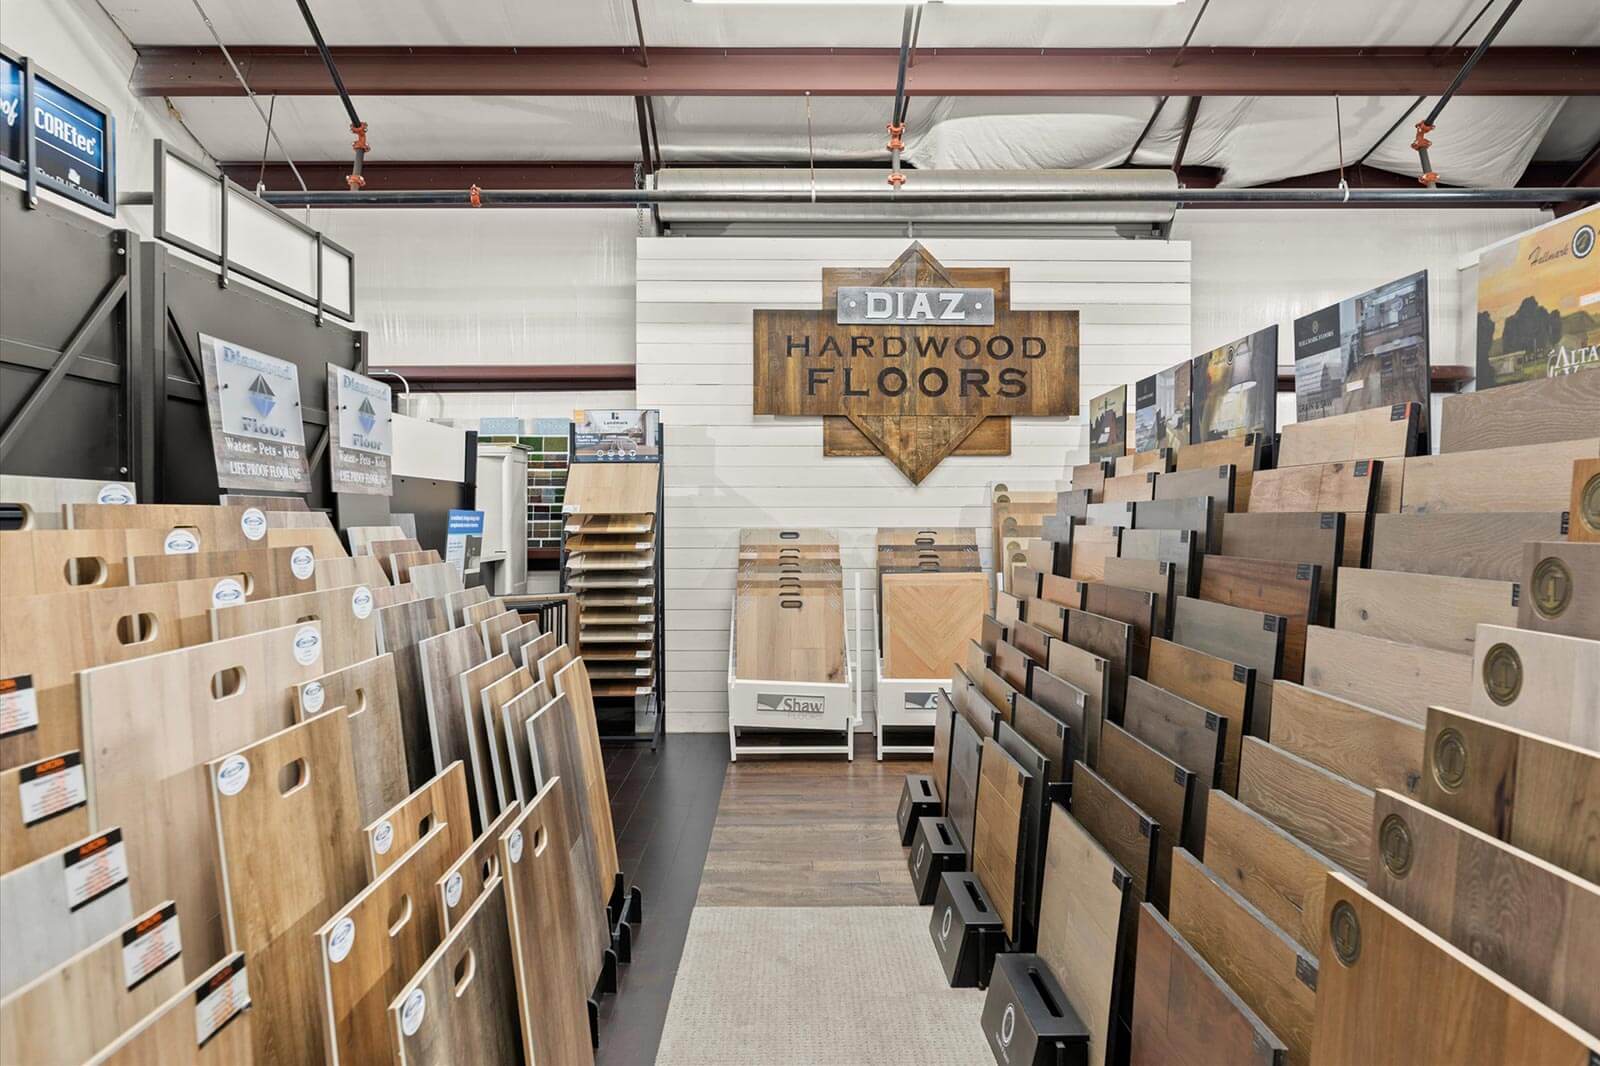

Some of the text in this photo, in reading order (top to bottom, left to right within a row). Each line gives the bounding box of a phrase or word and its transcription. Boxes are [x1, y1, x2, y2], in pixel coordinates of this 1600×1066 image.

[1528, 244, 1569, 266] Hallmark
[865, 291, 966, 320] DIAZ
[786, 335, 1046, 360] HARDWOOD
[1555, 345, 1599, 369] ALTA
[807, 366, 1028, 398] FLOORS
[224, 437, 251, 454] Water
[258, 442, 277, 457] Pets
[282, 446, 300, 460] Kids
[784, 697, 823, 712] Shaw
